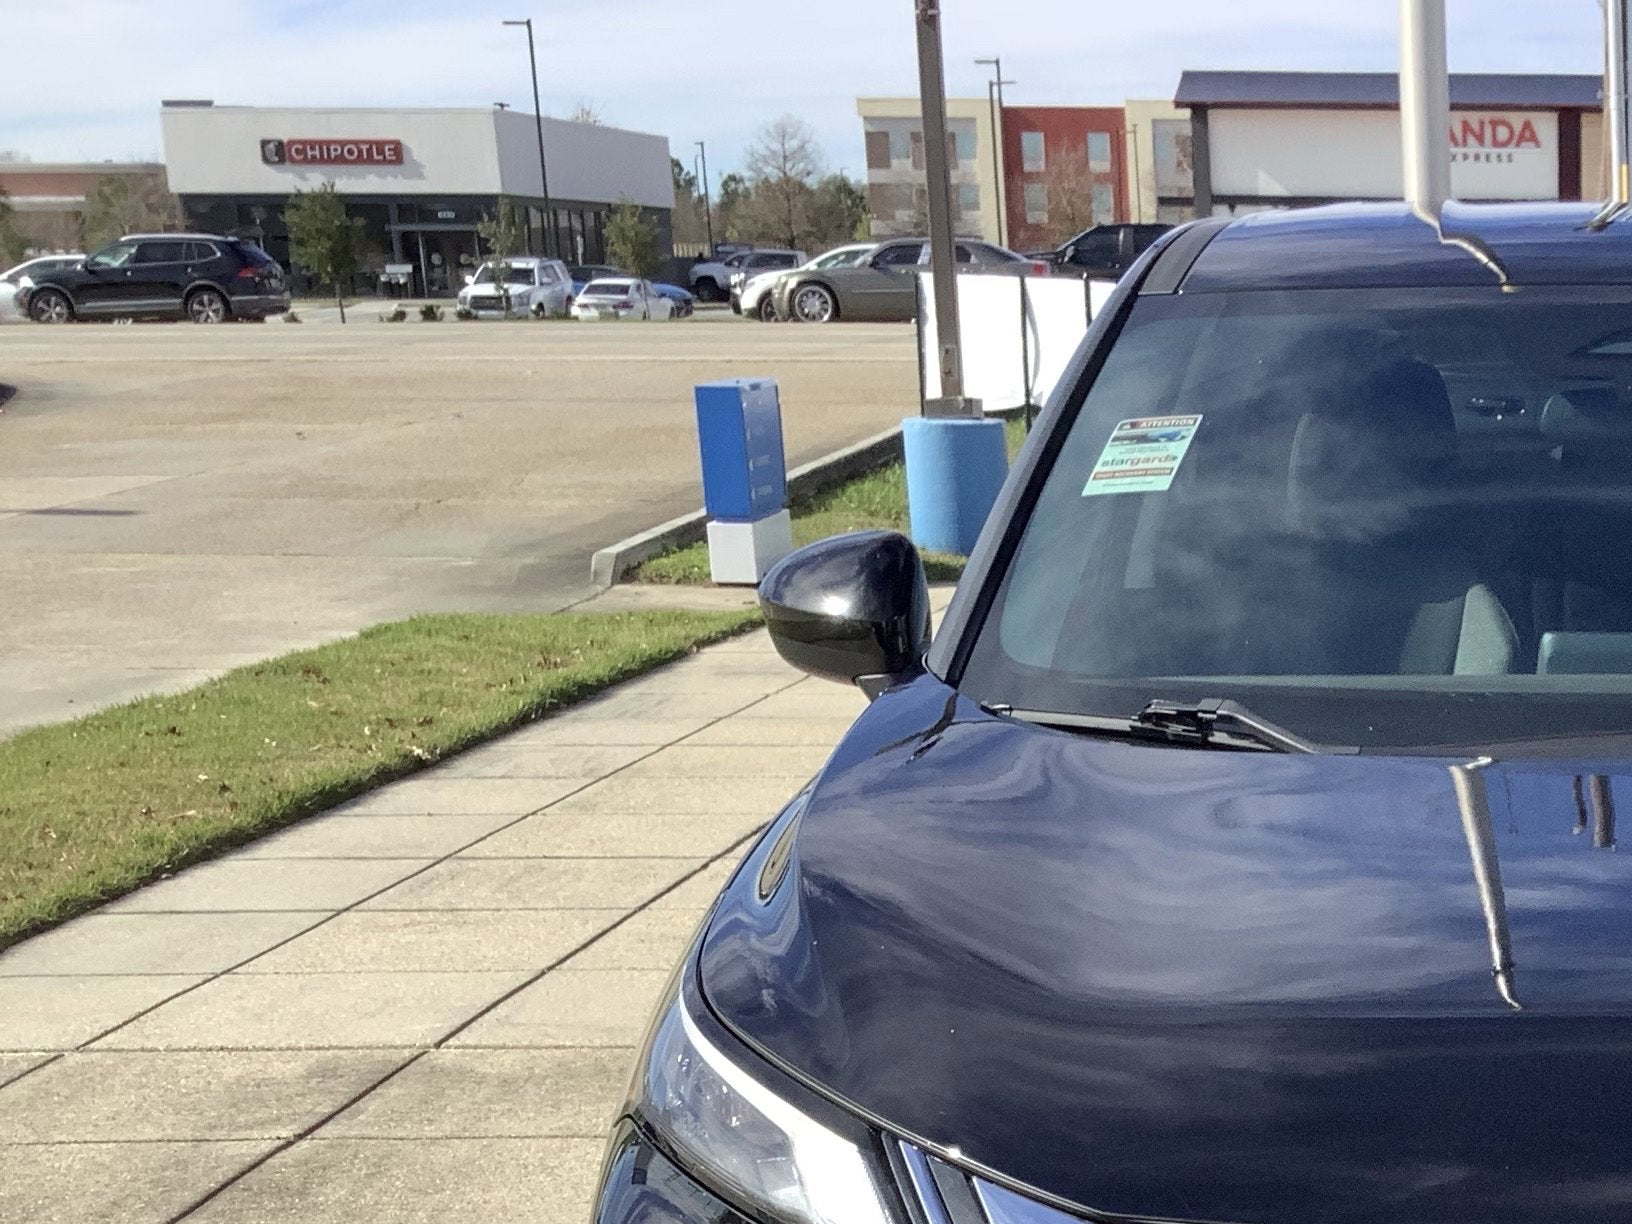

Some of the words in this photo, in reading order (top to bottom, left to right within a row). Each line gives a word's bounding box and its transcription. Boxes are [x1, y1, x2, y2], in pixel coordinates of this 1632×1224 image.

[1449, 118, 1541, 148] NDA
[290, 143, 397, 160] CHIPOTLE
[1450, 152, 1513, 163] XPRESS
[1140, 417, 1196, 429] ATTENTION
